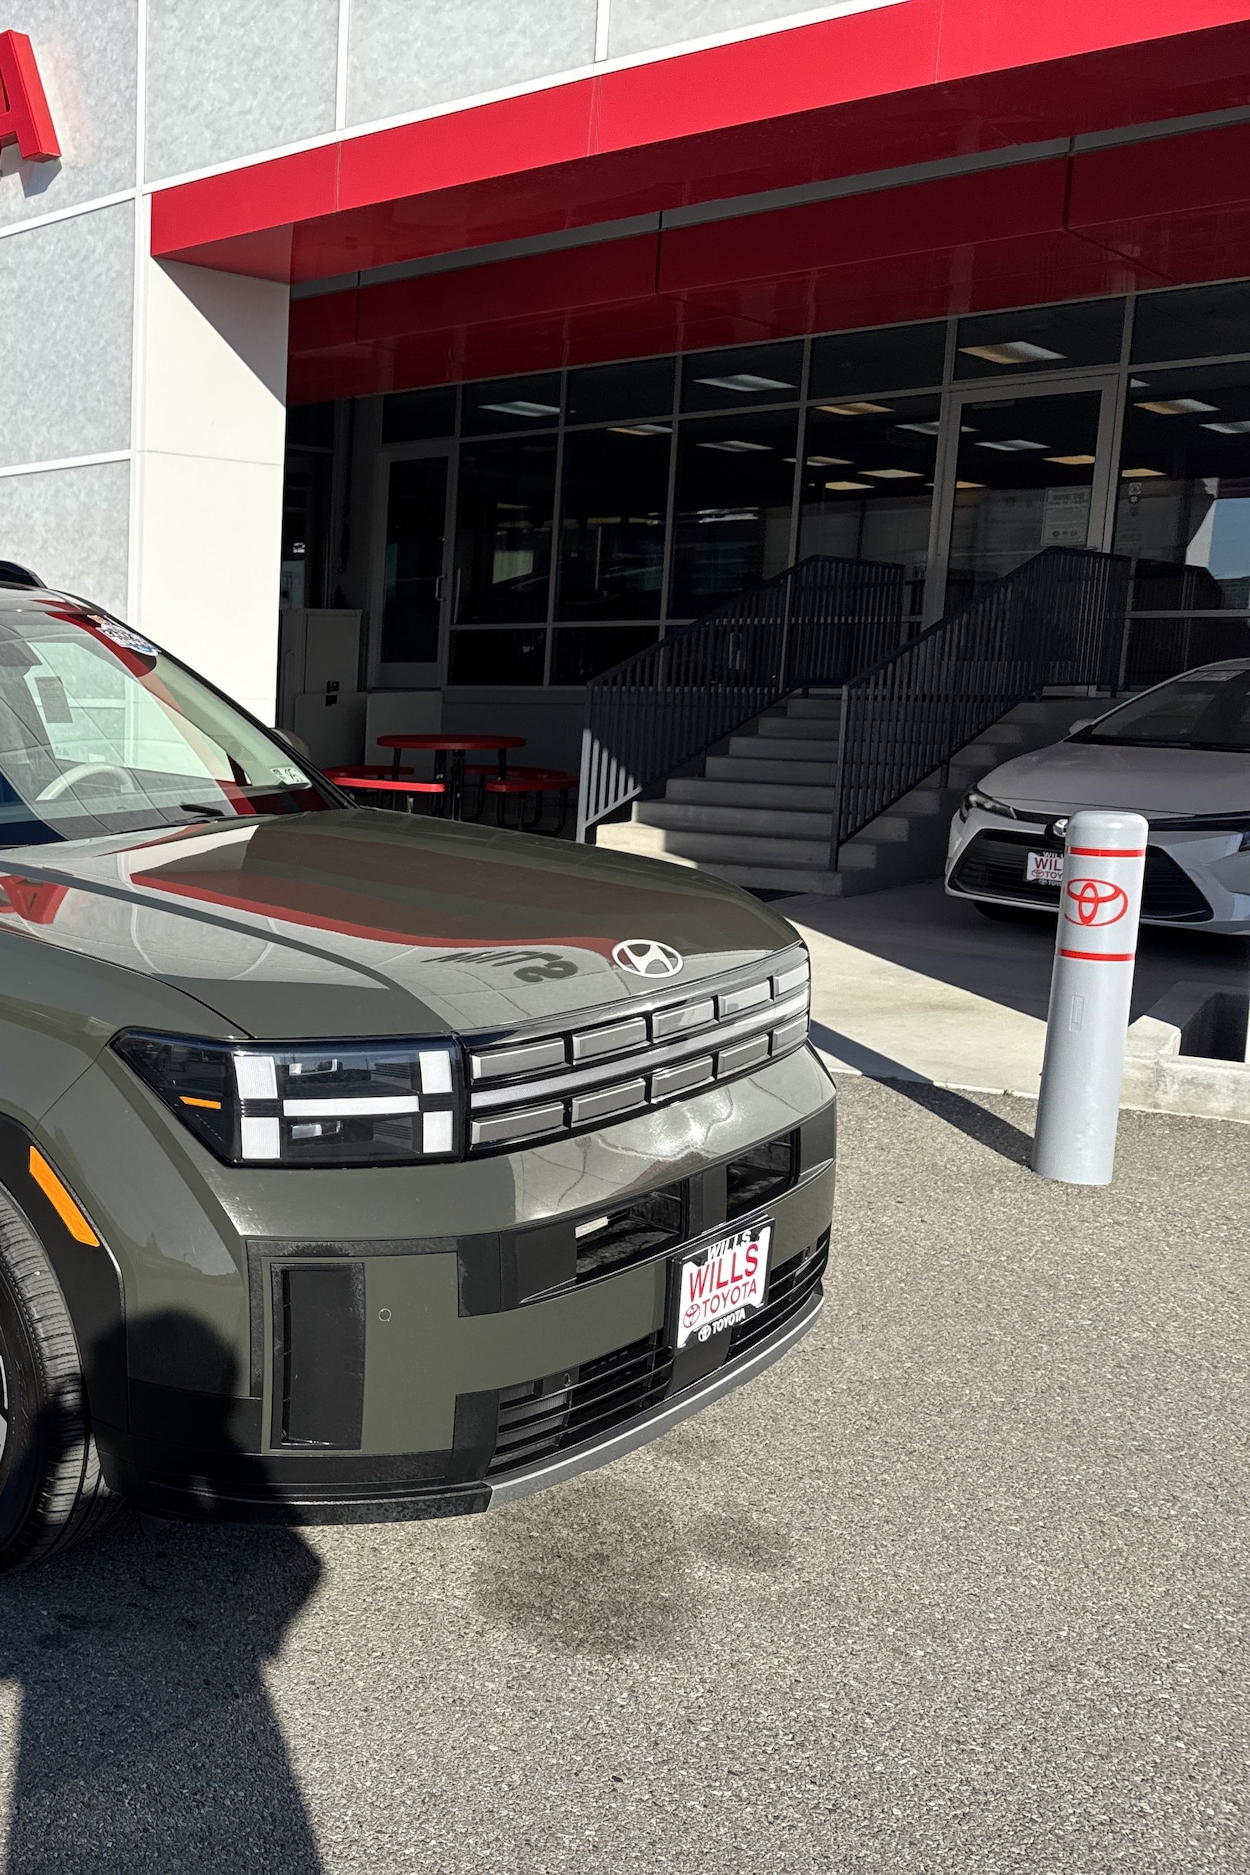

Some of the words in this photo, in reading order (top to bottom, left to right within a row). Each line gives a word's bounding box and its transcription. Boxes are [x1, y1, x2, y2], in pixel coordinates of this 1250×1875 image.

[1034, 856, 1063, 872] WIL
[1042, 851, 1064, 860] WILL
[1044, 871, 1064, 879] TOY
[707, 1229, 752, 1262] WILLS
[689, 1243, 759, 1303] WILLS
[702, 1278, 757, 1318] TOYOTA
[712, 1307, 746, 1335] TOYOTA
